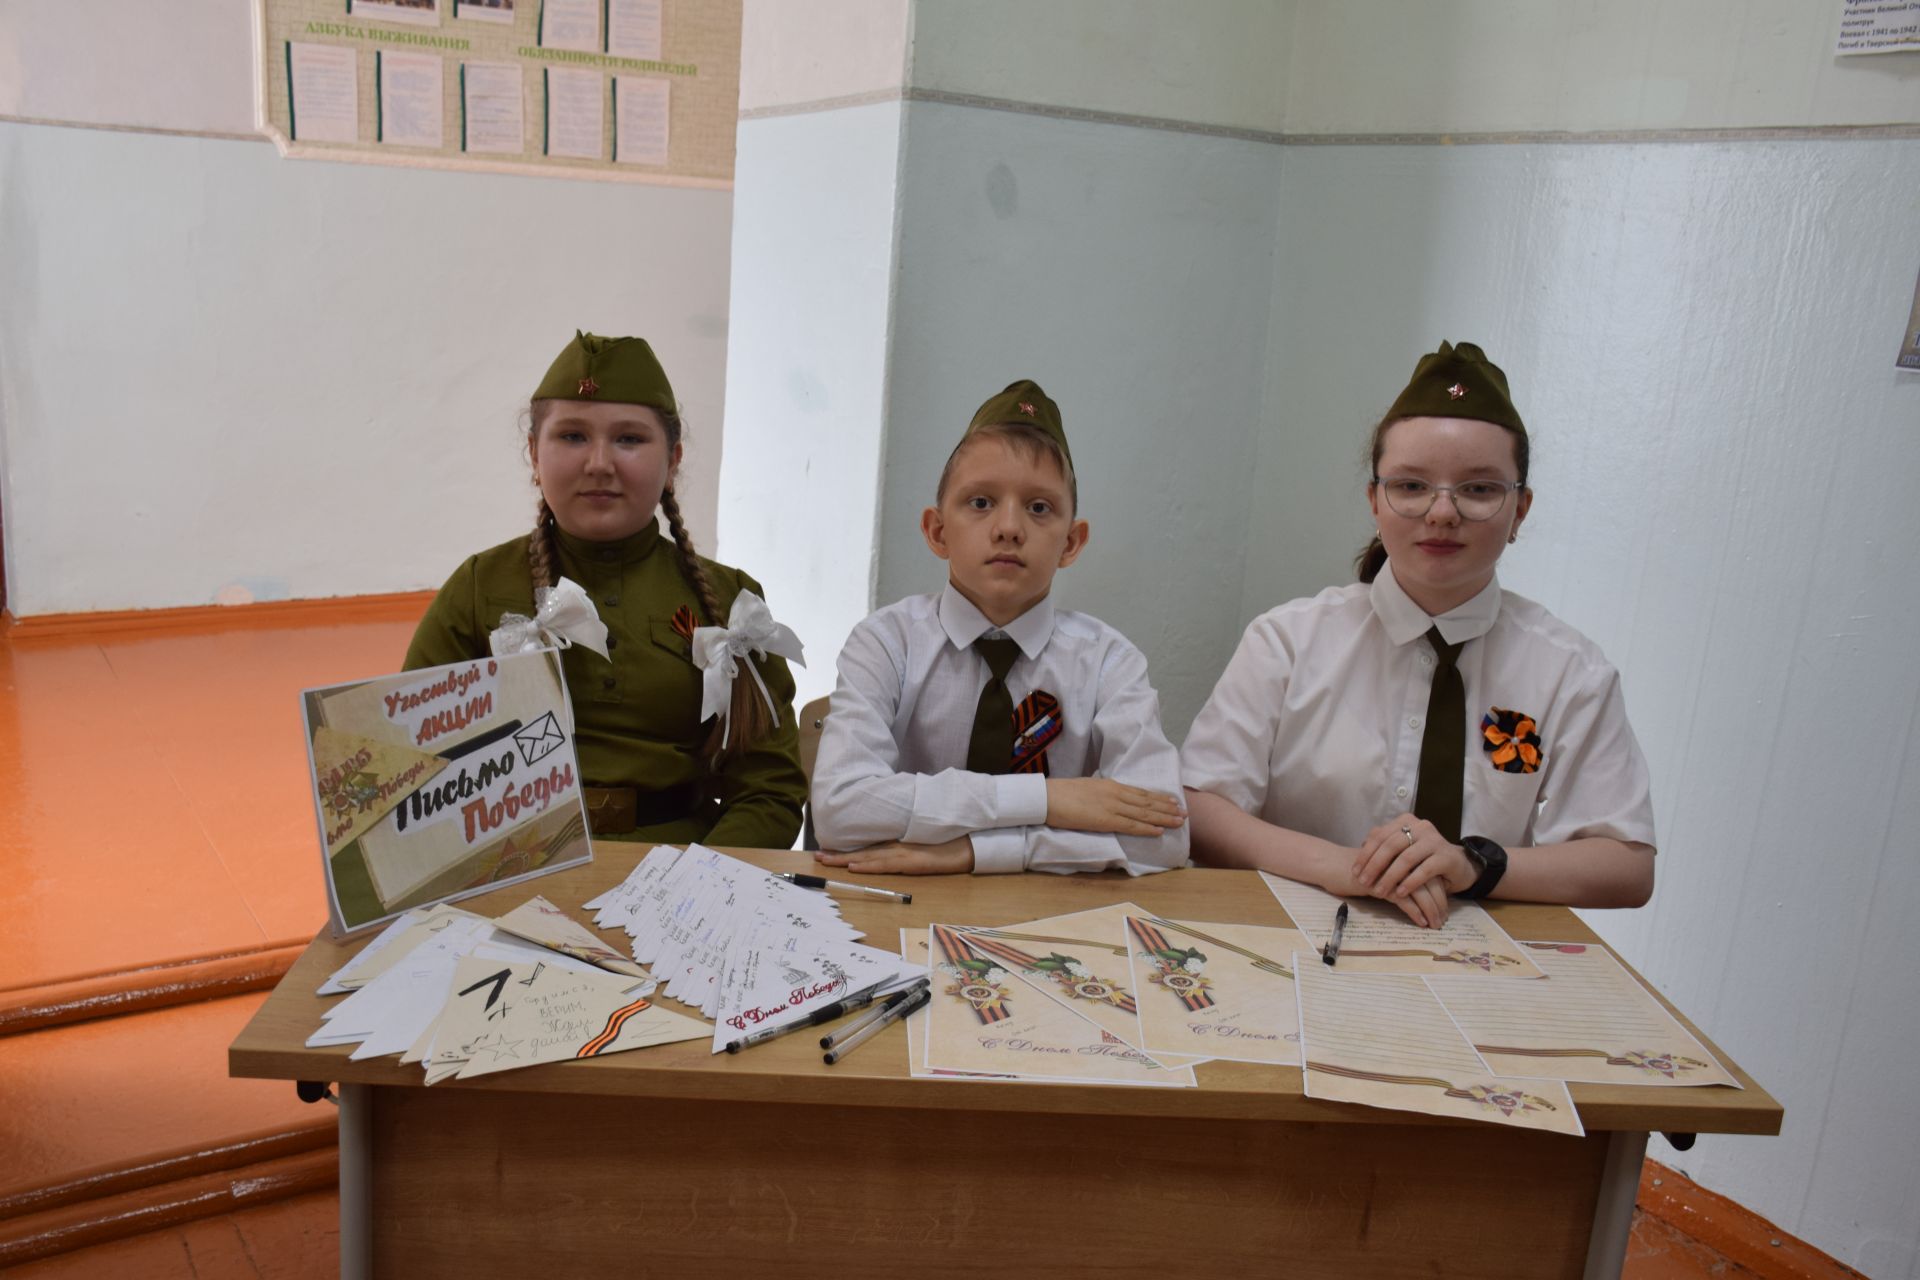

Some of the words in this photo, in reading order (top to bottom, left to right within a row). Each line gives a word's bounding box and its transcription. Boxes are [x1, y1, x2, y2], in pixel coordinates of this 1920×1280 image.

[305, 21, 365, 39] АЗБУКА
[368, 29, 471, 50] ВЫЖИВАНИЯ
[1872, 28, 1888, 36] 1941
[517, 47, 618, 67] ОБЯЗАННОСТИ
[620, 57, 698, 77] РОДИТЕЛЕЙ
[384, 664, 481, 719] Участвуй
[396, 751, 515, 832] Письмо
[461, 763, 574, 844] Победы
